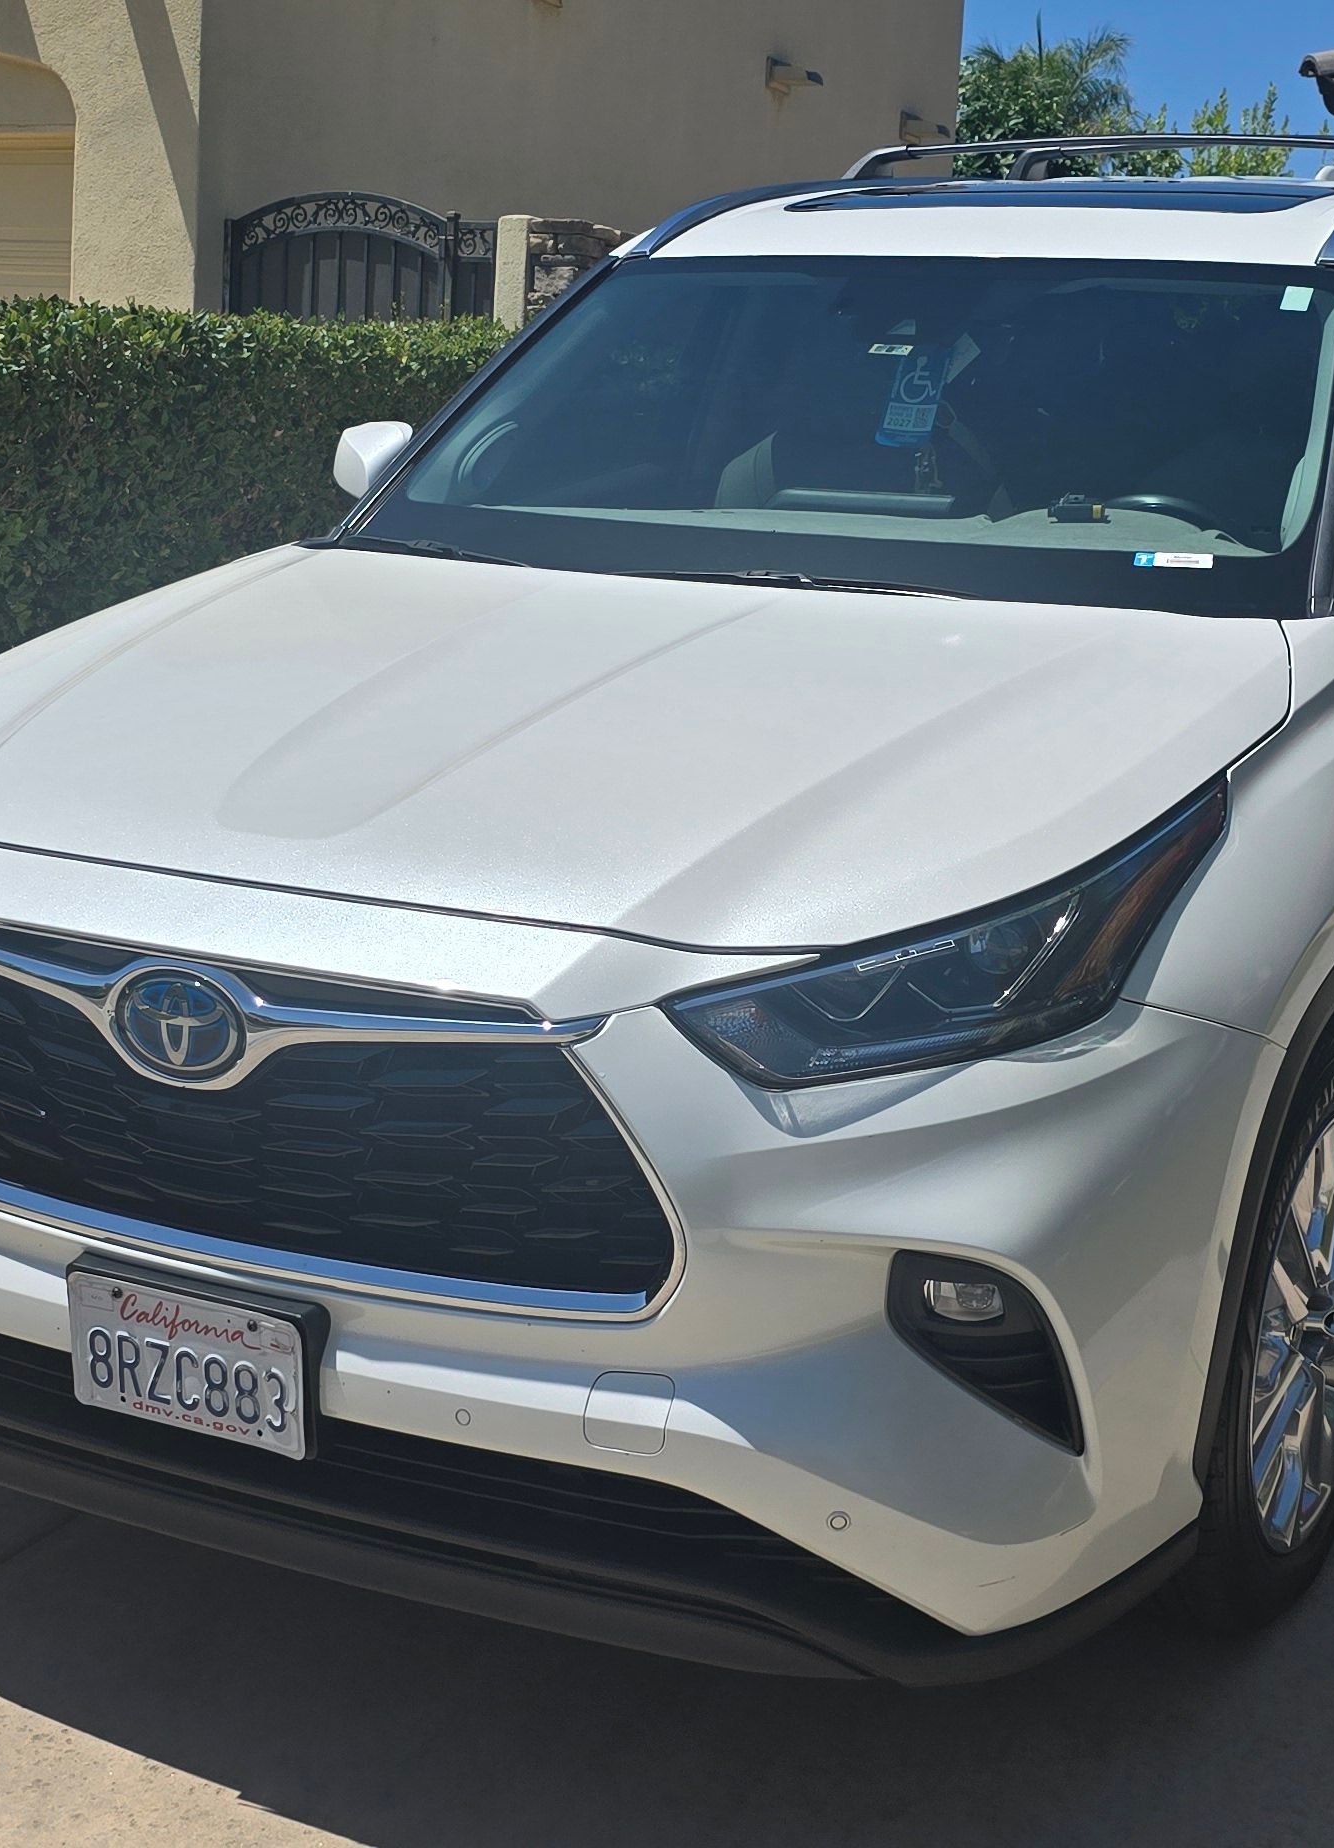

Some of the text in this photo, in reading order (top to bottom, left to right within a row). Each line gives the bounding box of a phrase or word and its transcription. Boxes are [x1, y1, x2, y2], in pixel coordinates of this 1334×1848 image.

[120, 1293, 261, 1350] California
[88, 1327, 287, 1432] 8RZC883
[132, 1402, 250, 1434] dmv.ca.gov
